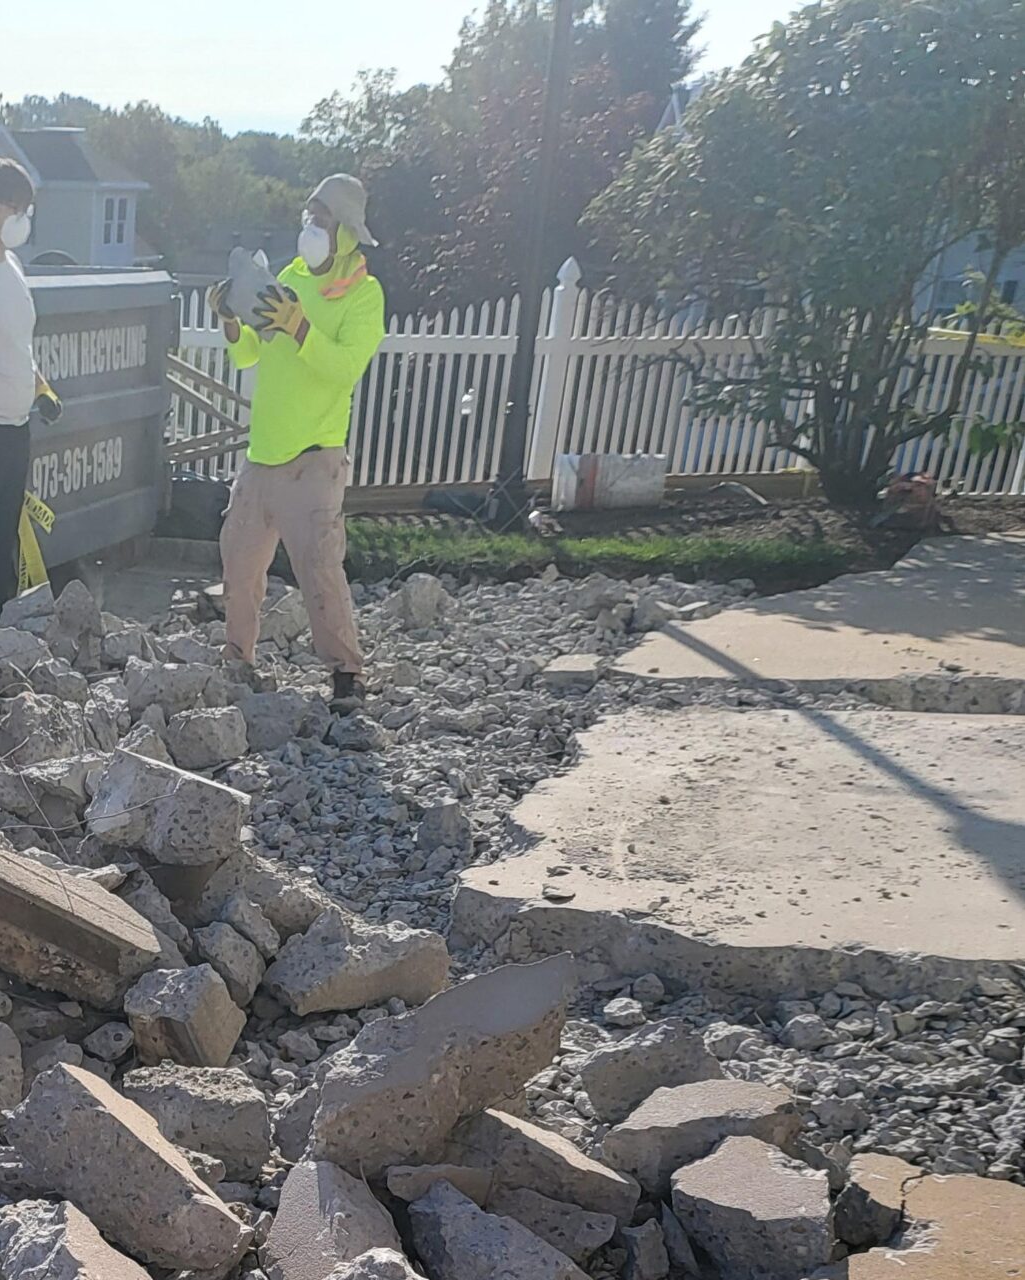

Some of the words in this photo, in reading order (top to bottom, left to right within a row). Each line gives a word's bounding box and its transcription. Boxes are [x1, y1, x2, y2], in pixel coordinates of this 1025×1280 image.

[33, 332, 79, 382] ERSON
[81, 324, 148, 376] RECYCLING
[32, 436, 123, 500] 973-361-1589
